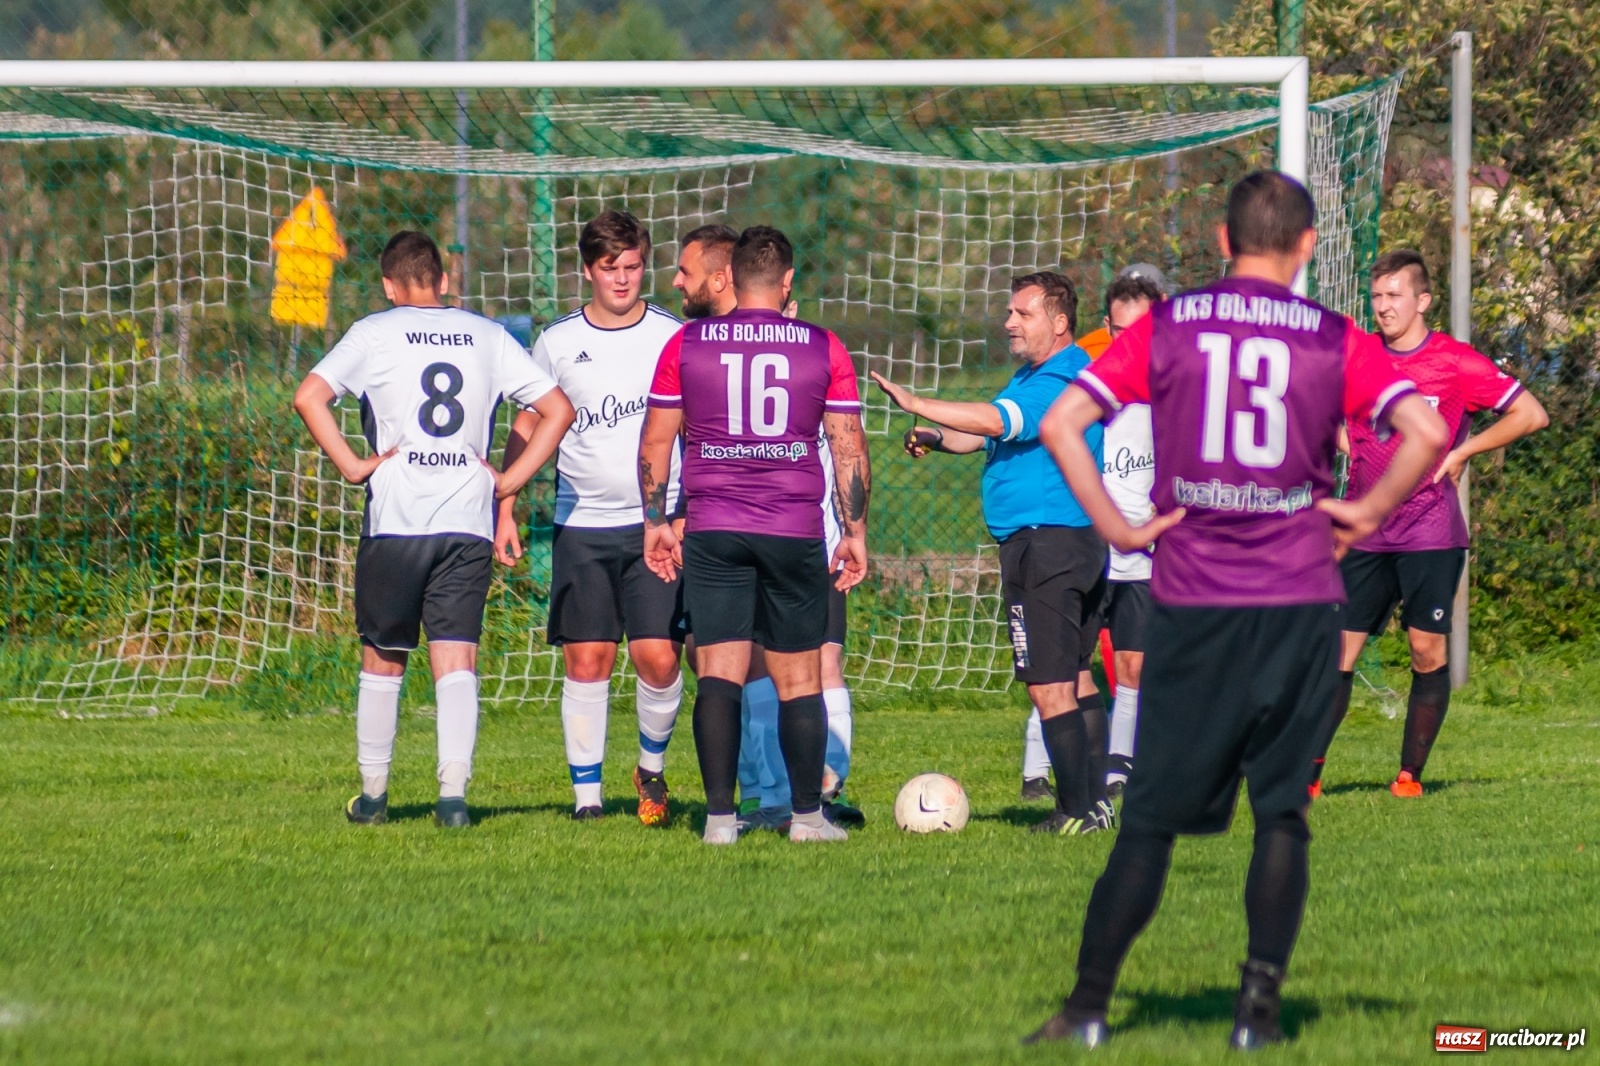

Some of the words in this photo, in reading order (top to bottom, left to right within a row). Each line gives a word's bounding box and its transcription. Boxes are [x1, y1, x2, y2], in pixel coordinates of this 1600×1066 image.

[1173, 293, 1214, 324] LKS
[405, 332, 474, 347] WICHER
[701, 323, 729, 342] LKS
[733, 322, 810, 344] BOJANÓW
[418, 361, 465, 438] 8
[720, 352, 790, 437] 16
[1197, 331, 1291, 468] 13
[408, 451, 467, 467] PŁONIA
[702, 441, 808, 461] kosiarka.pl
[1173, 476, 1313, 517] ksiarka.pl
